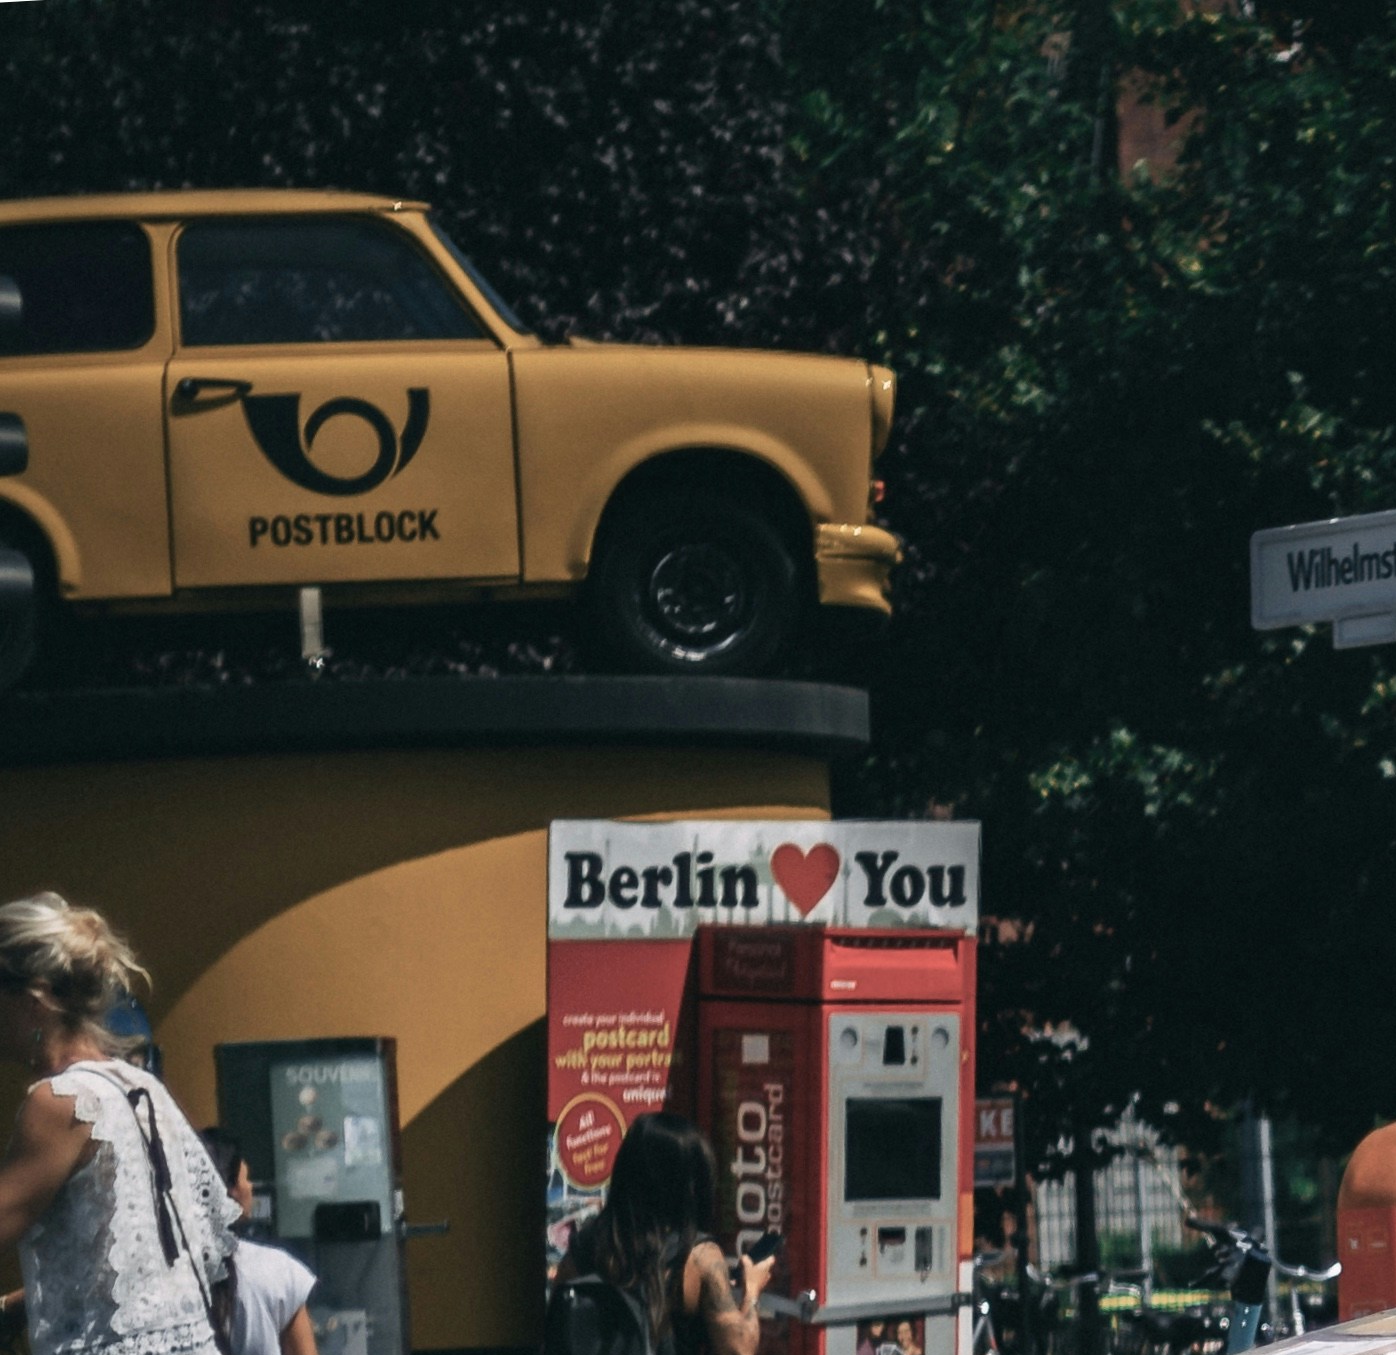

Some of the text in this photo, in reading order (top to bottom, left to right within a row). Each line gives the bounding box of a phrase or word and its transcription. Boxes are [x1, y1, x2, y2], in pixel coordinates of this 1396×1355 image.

[249, 510, 441, 549] POSTBLOCK
[563, 850, 968, 910] Berlin You
[562, 1009, 665, 1029] create your individual
[584, 1021, 670, 1055] postcard
[555, 1048, 682, 1074] with your portra
[591, 1071, 608, 1085] the
